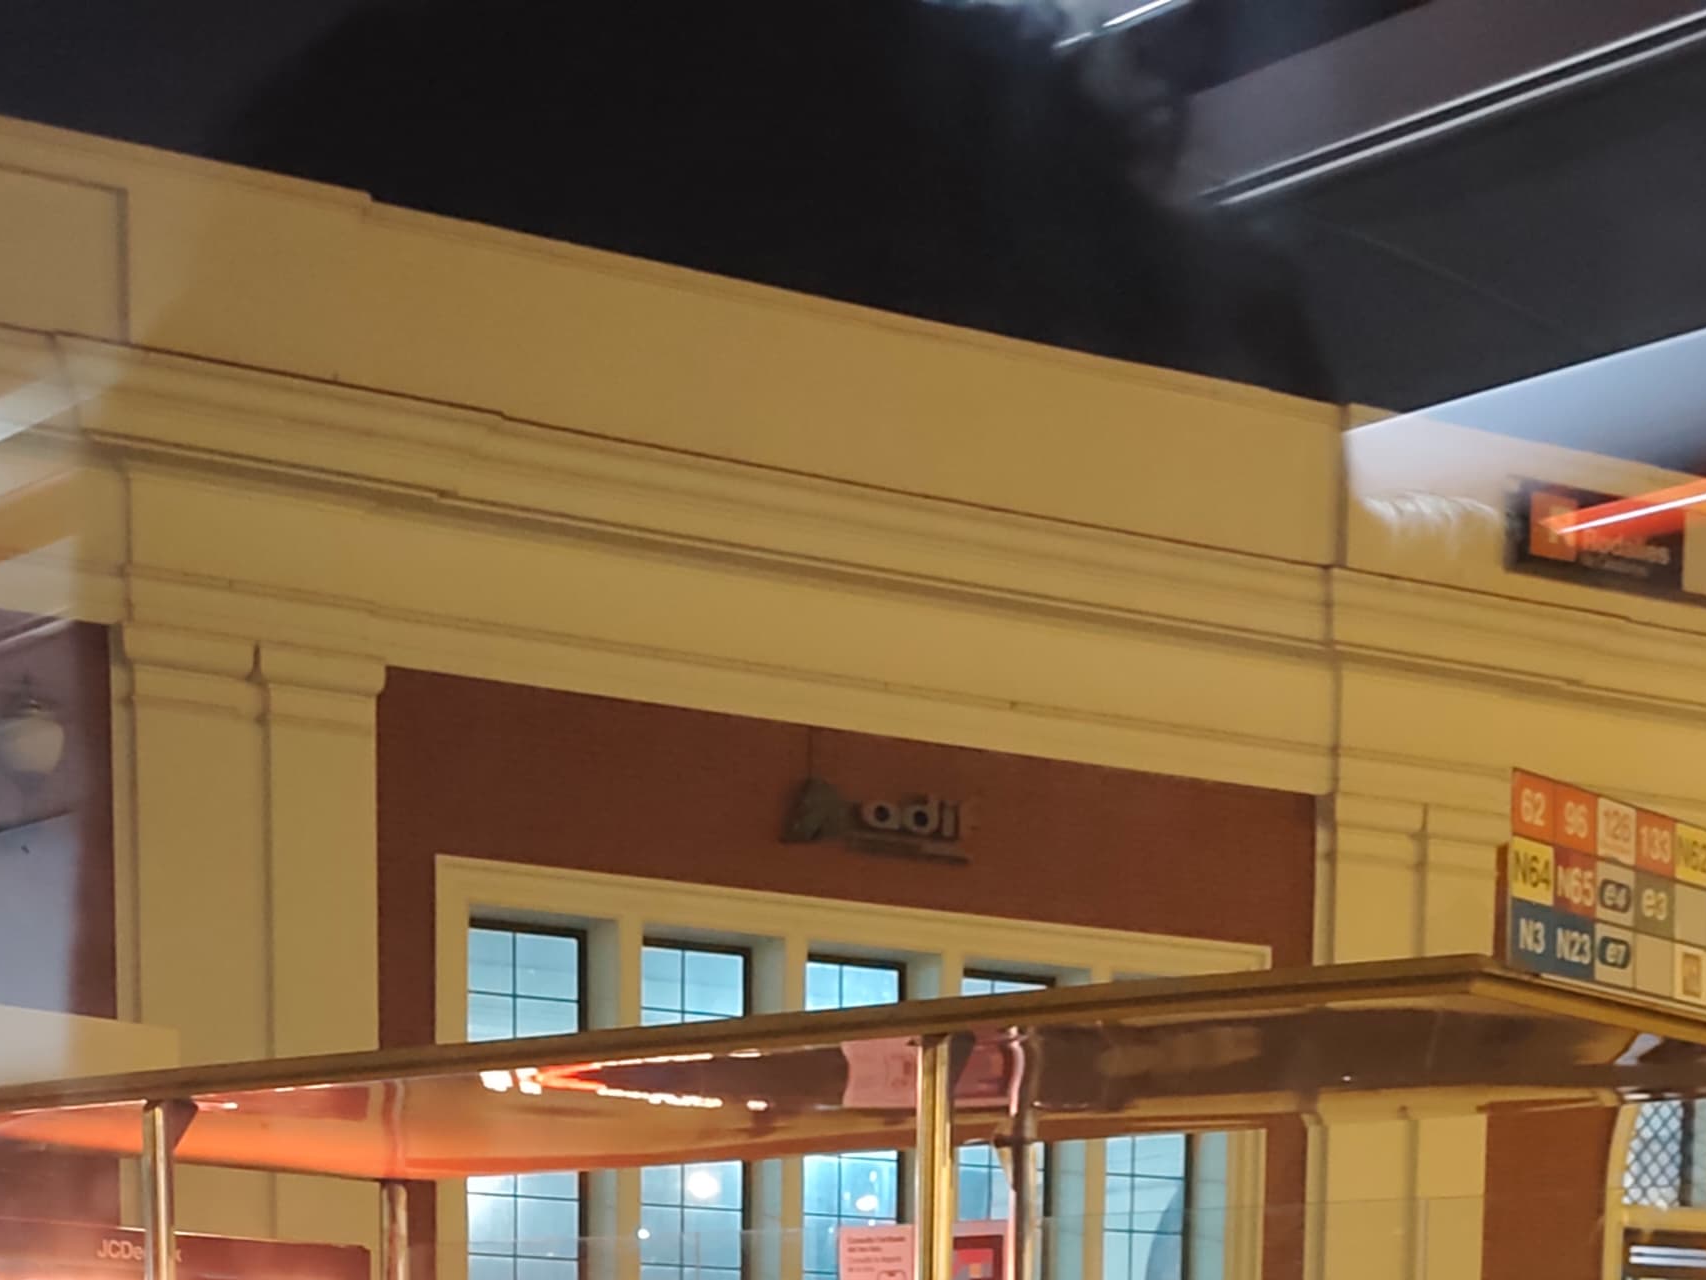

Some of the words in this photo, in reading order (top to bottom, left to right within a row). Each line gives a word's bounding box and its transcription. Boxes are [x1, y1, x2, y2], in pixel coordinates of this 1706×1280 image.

[1520, 788, 1546, 827] 62
[1564, 801, 1589, 839] 96
[1602, 806, 1633, 843] 126
[1639, 824, 1671, 864] 133
[1512, 851, 1551, 892] N64
[1557, 865, 1594, 907] N65
[1603, 882, 1626, 907] e4
[1642, 888, 1668, 921] e3
[1519, 918, 1545, 955] N3
[1556, 927, 1592, 965] N23
[1604, 941, 1626, 962] e7
